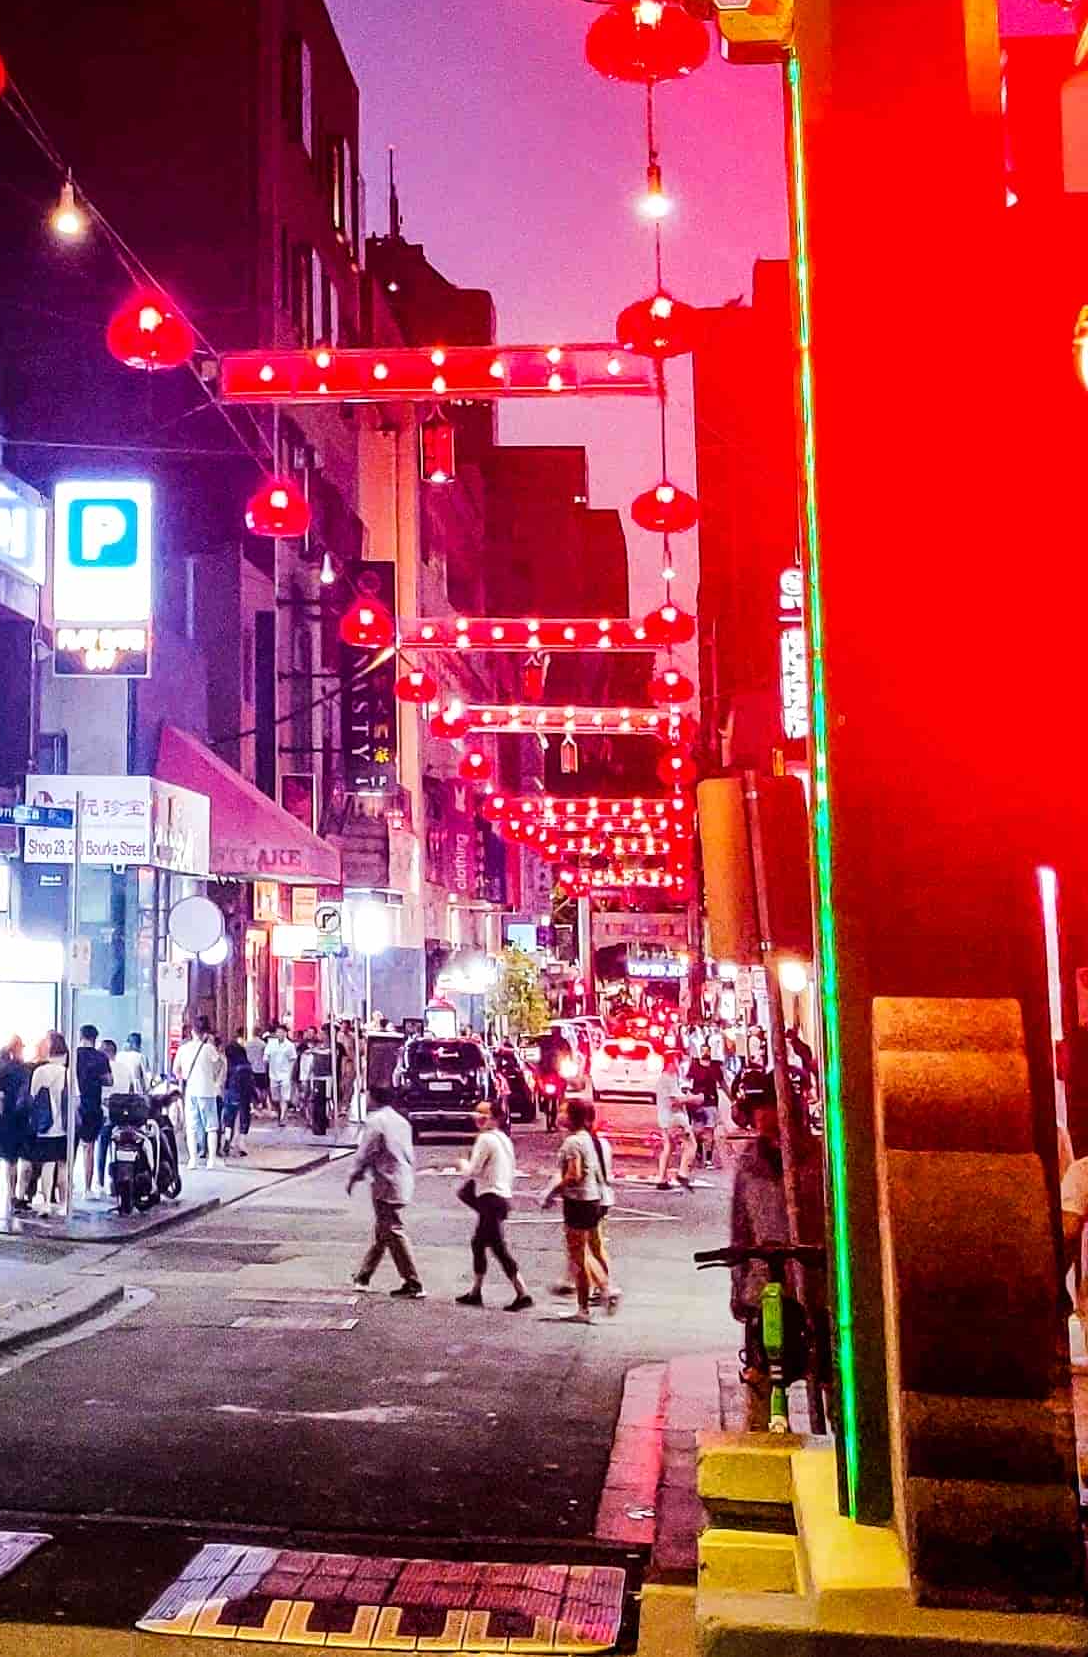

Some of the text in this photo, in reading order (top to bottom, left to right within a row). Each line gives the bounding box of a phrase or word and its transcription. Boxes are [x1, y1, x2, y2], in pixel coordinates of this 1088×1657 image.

[80, 504, 127, 561] P
[28, 839, 53, 857] Shop
[86, 839, 117, 858] Bourke
[119, 841, 146, 859] Street
[453, 833, 470, 890] clothing
